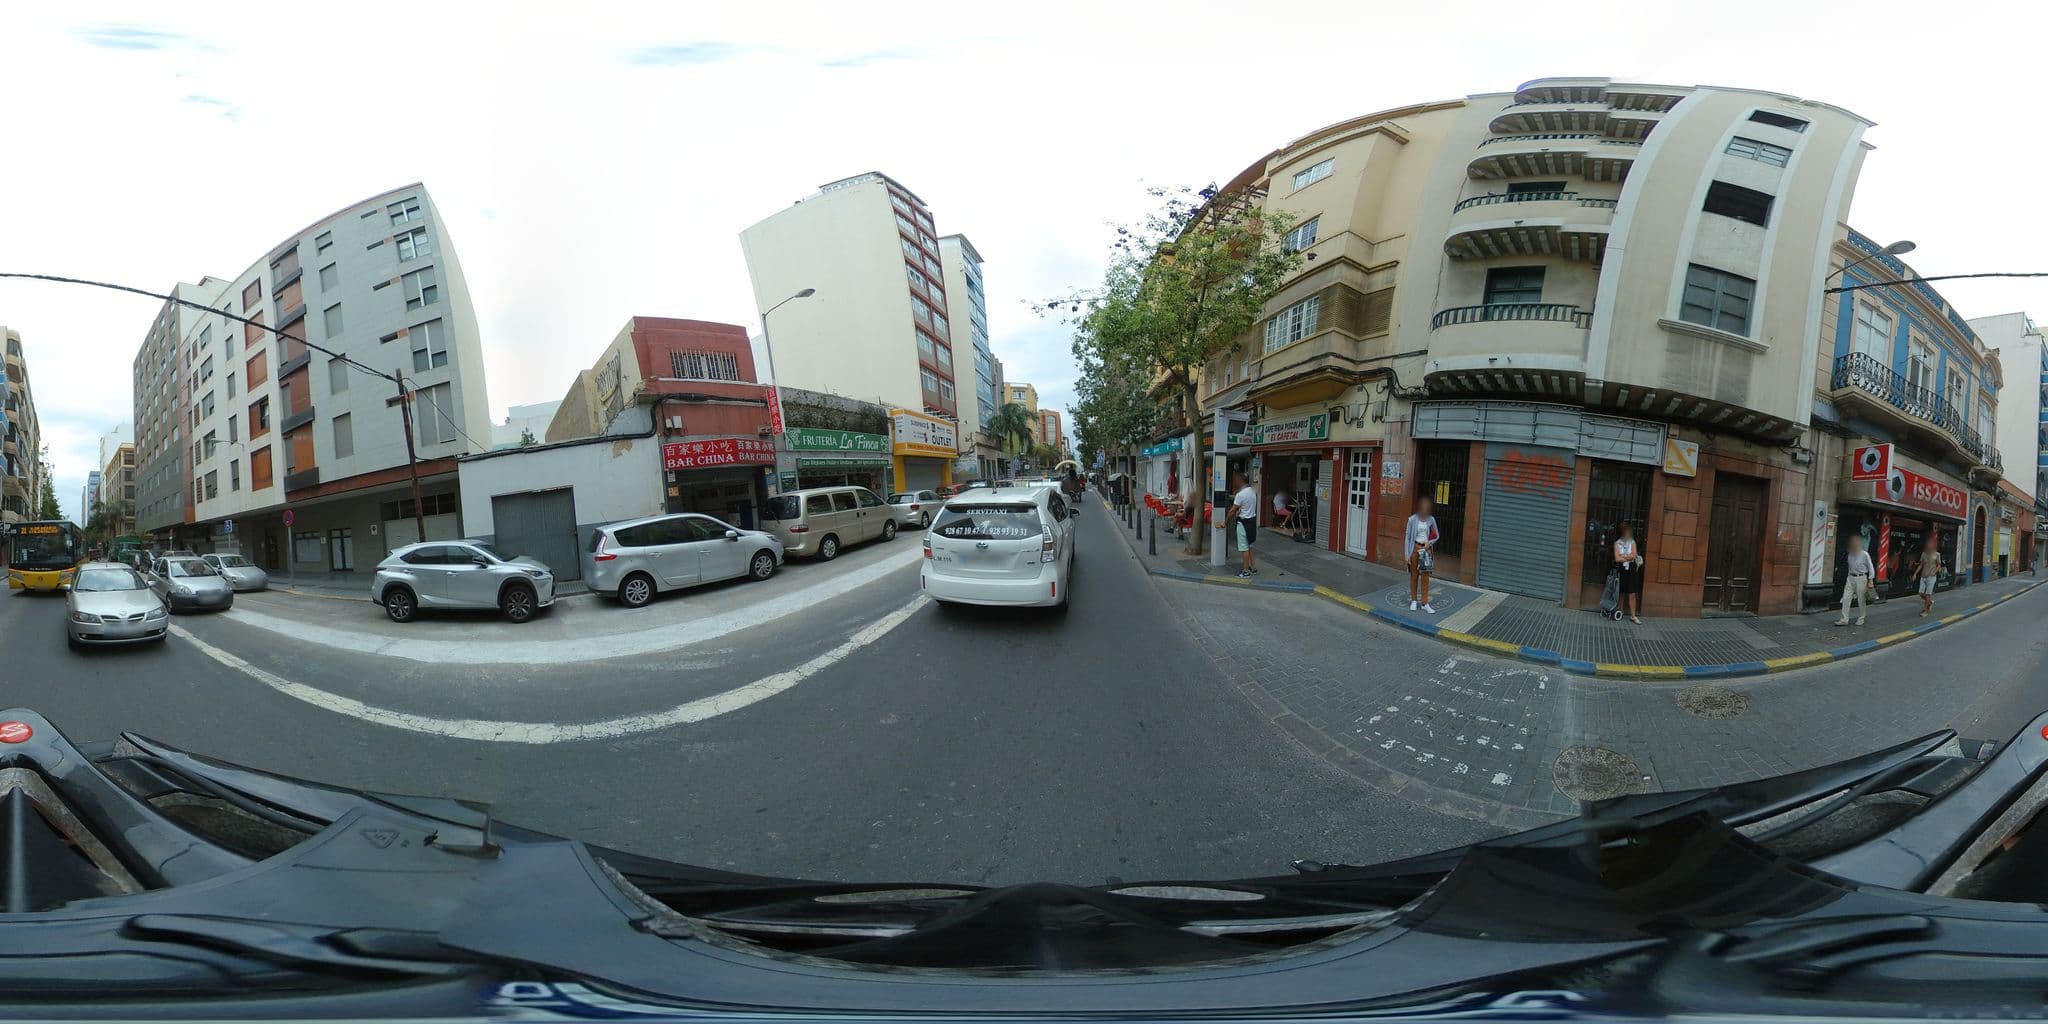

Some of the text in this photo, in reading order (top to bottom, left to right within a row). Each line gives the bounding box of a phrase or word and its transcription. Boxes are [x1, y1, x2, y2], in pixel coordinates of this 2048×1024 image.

[666, 440, 733, 456] 百家樂小吃
[803, 433, 879, 450] FRUTERÍA La Finca
[931, 435, 952, 447] OUTLET
[667, 454, 735, 468] BAR CHINA
[739, 452, 776, 462] BAR CHINA
[1913, 478, 1962, 510] iss2000
